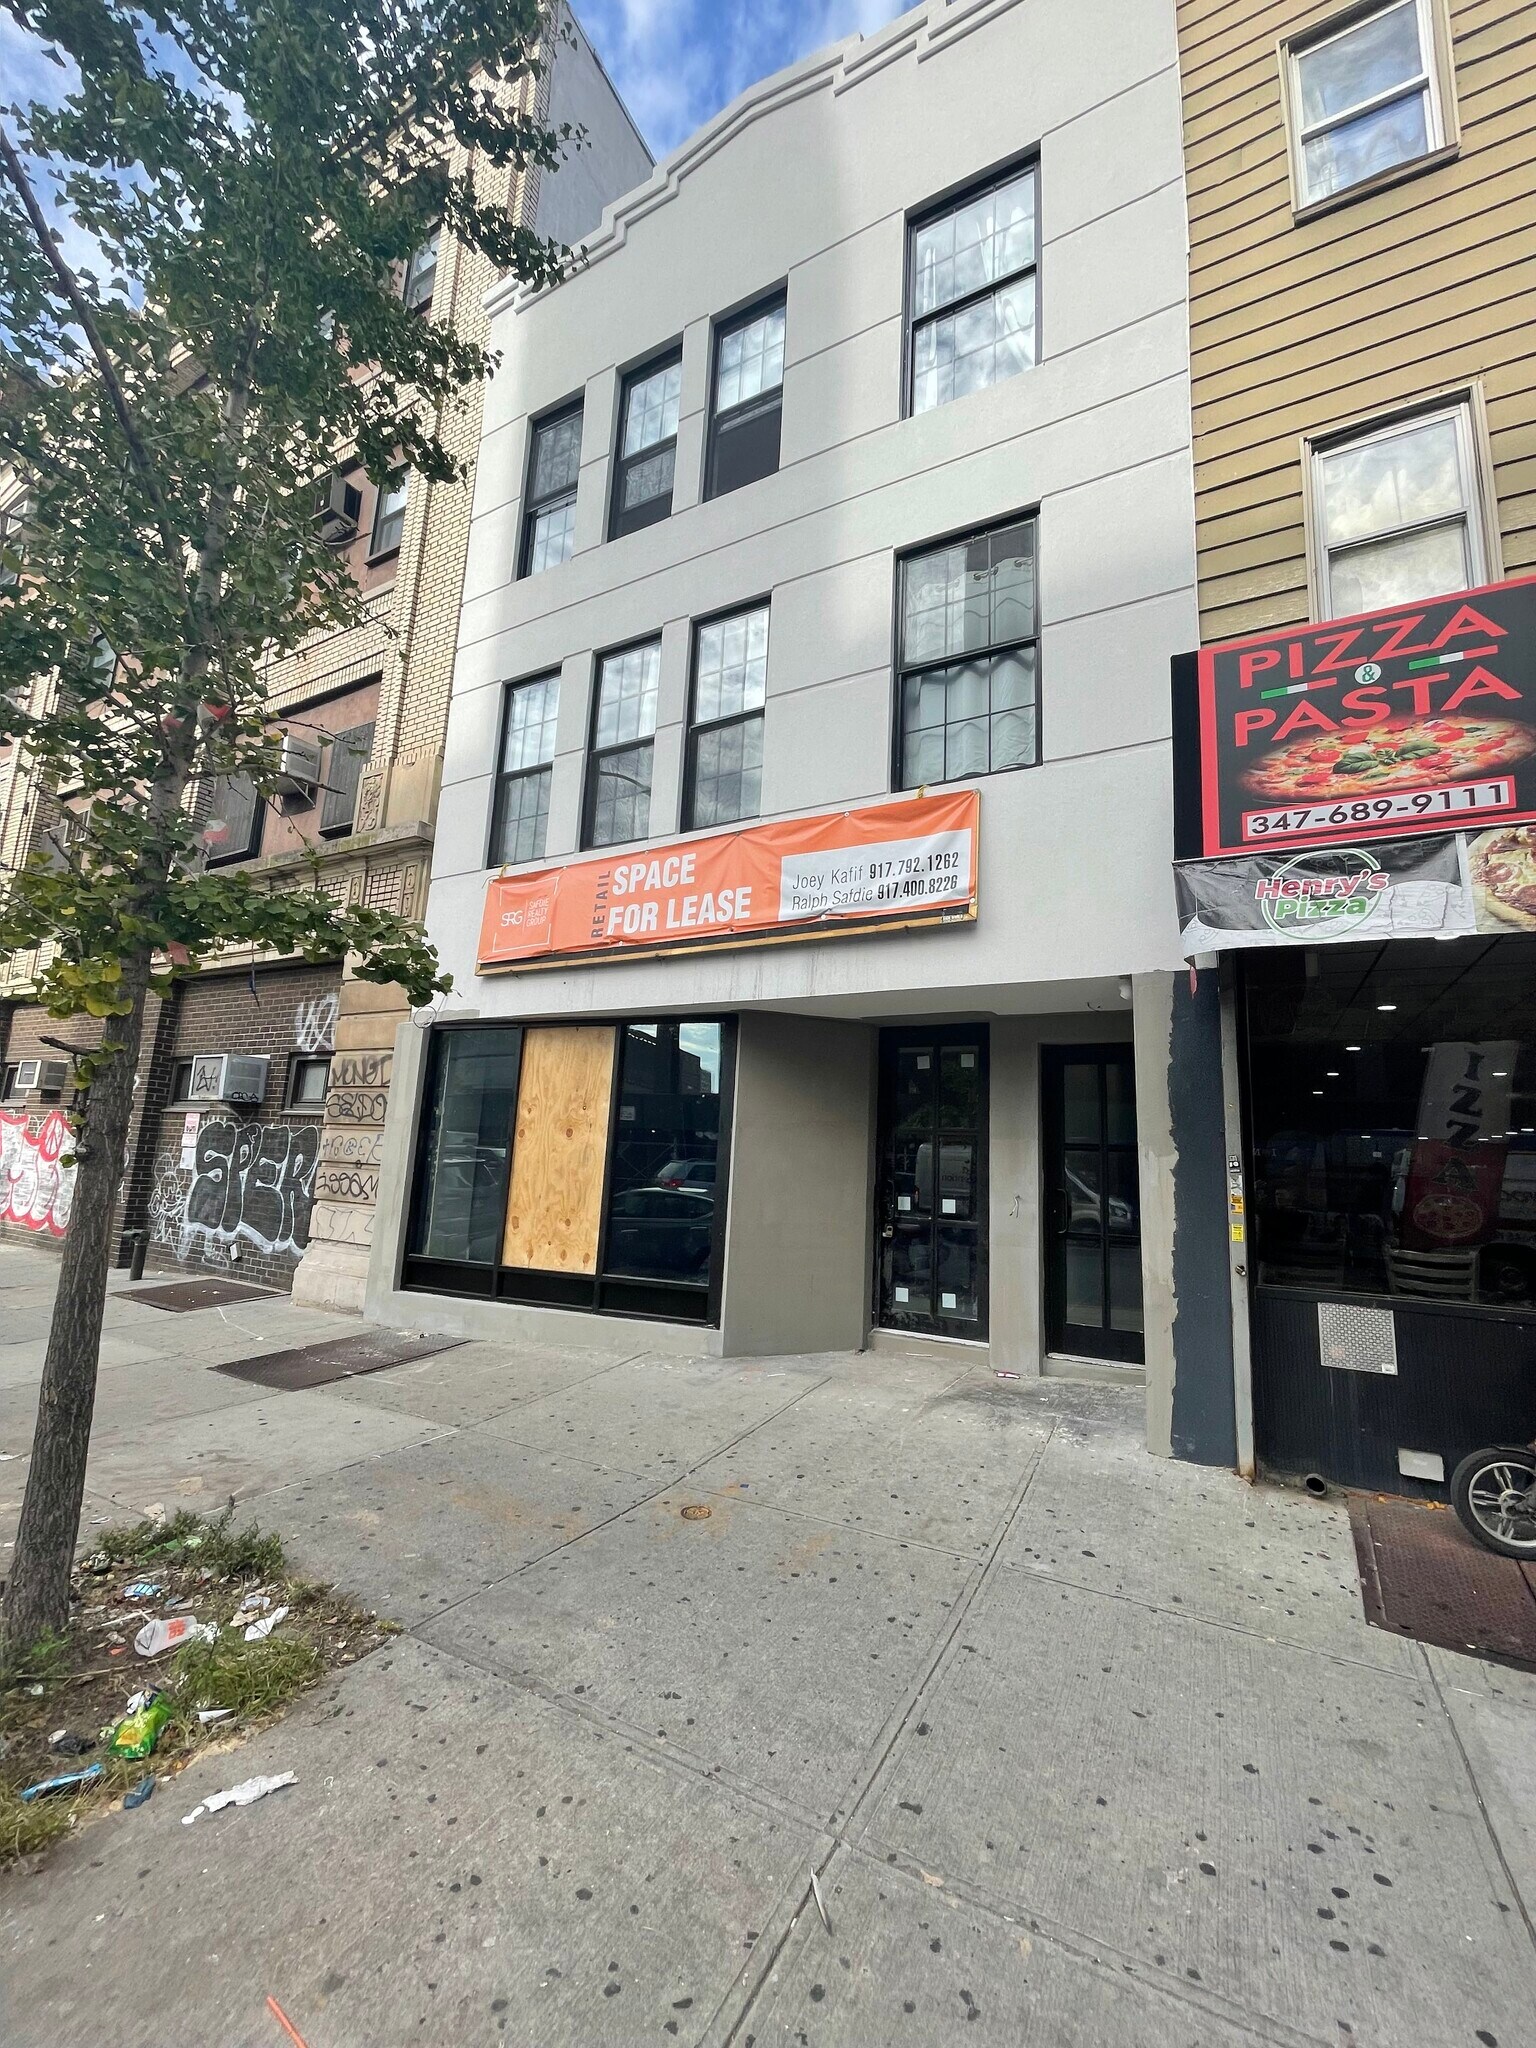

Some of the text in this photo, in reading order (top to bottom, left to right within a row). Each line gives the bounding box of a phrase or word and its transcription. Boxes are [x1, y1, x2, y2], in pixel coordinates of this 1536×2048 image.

[1239, 604, 1508, 688] PIZZA
[1361, 664, 1378, 683] &
[1235, 666, 1523, 747] PASTA
[1251, 784, 1503, 835] 347-689-9111
[612, 853, 697, 896] SPACE
[792, 852, 959, 890] Joey Kafif 917.792.1262
[1255, 868, 1390, 900] Henry's
[500, 910, 523, 927] SRG
[591, 870, 611, 938] RETAIL
[607, 886, 752, 936] FOR LEASE
[792, 893, 828, 911] Ralph
[832, 888, 873, 906] Safdie
[1273, 894, 1368, 920] Pizza
[526, 916, 547, 927] GROUP
